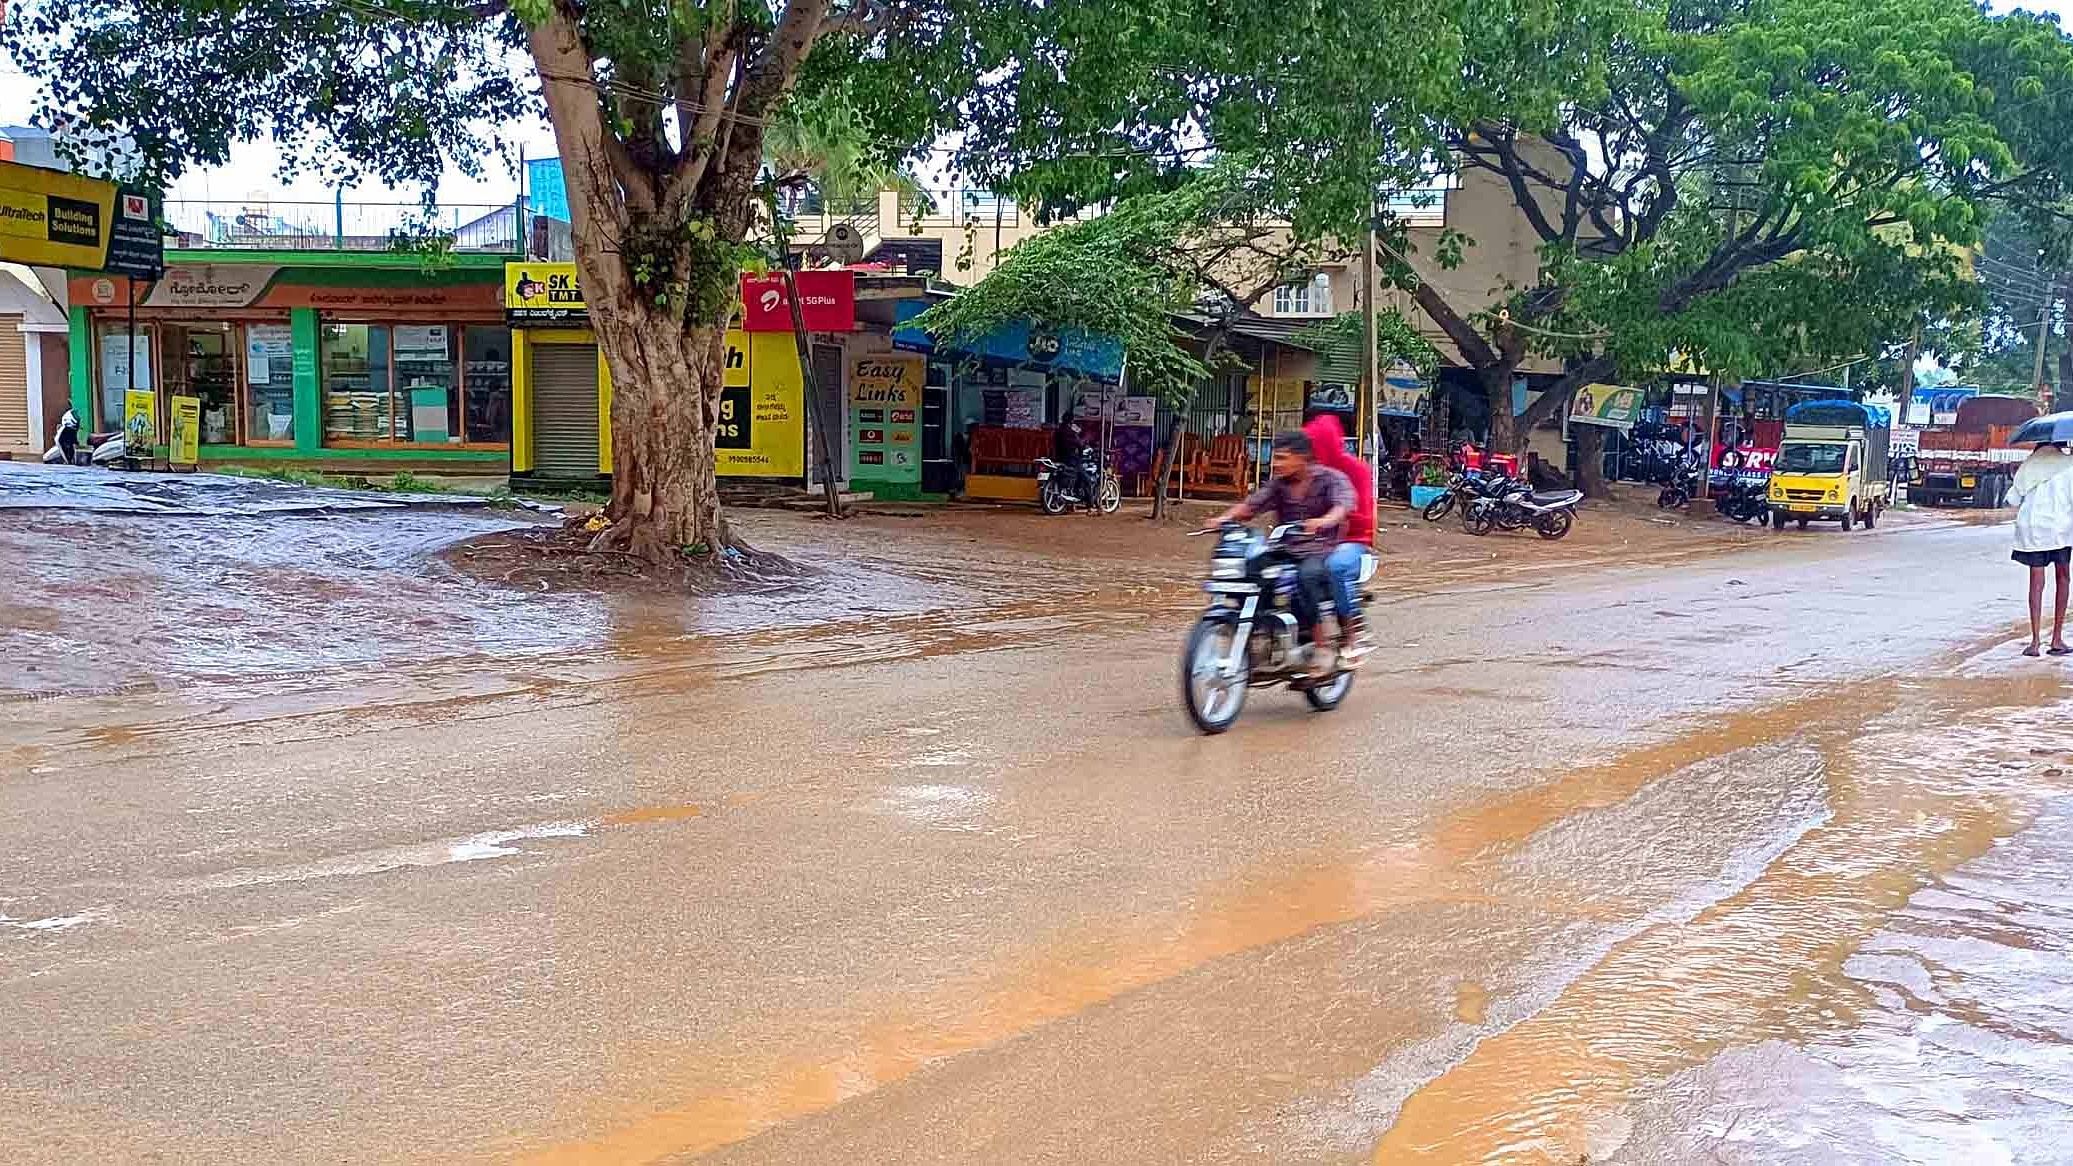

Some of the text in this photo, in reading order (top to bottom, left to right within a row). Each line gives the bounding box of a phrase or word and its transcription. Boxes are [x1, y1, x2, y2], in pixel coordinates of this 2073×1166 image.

[54, 207, 94, 225] Building
[52, 221, 96, 236] Solutions
[550, 291, 577, 301] TMT
[857, 360, 906, 383] Easy
[855, 384, 907, 401] Links
